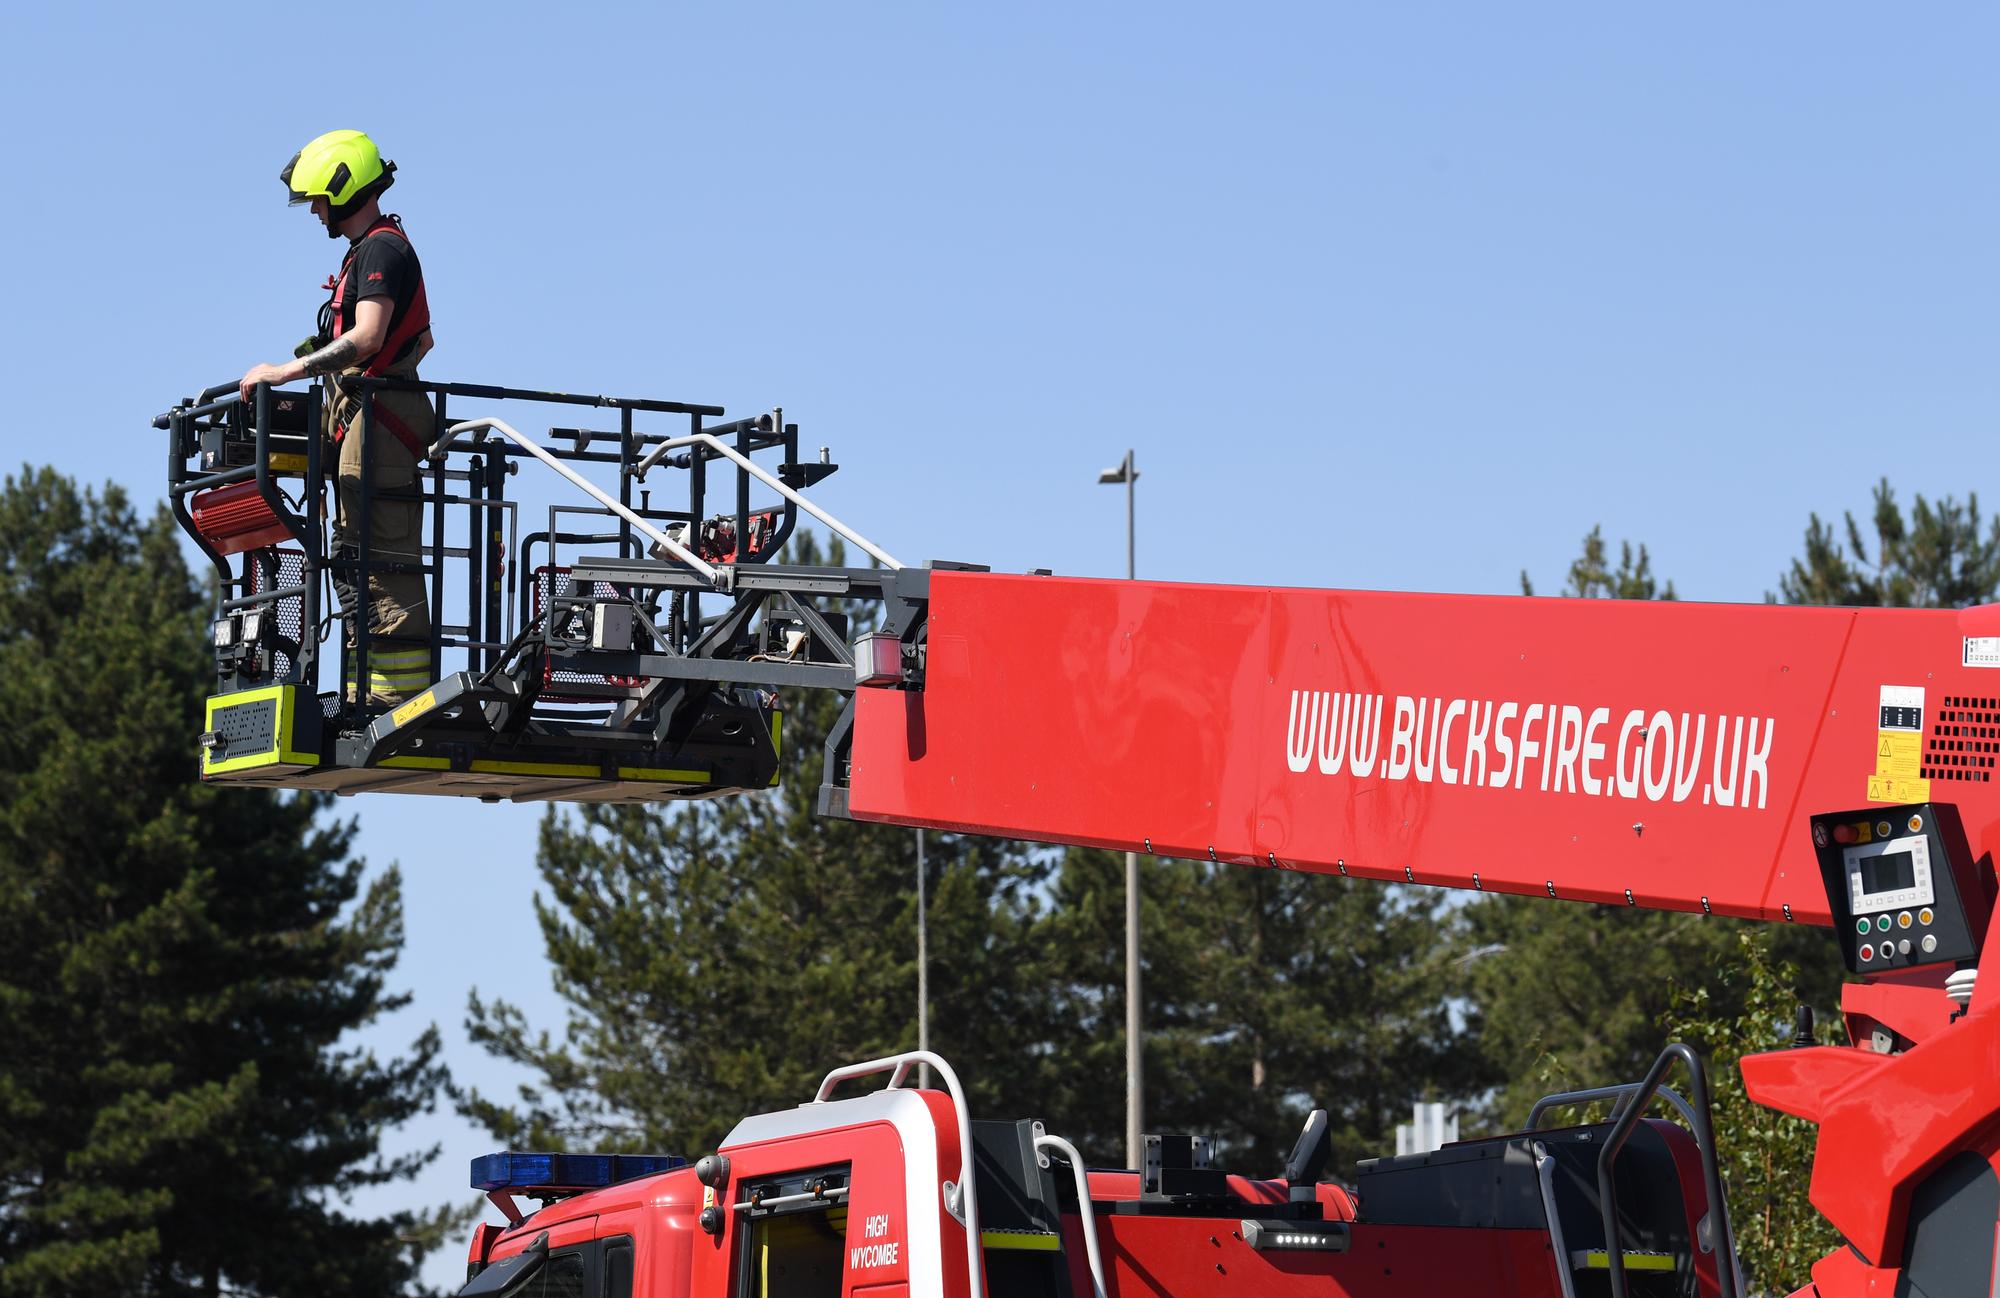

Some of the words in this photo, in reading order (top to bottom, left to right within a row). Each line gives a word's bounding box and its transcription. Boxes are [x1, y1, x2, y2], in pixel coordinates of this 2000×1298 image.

[1286, 690, 1775, 809] WWW.BUCKSFIRE.GOV.UK
[865, 1214, 889, 1239] HIGH
[851, 1242, 899, 1270] WYCOMBE
